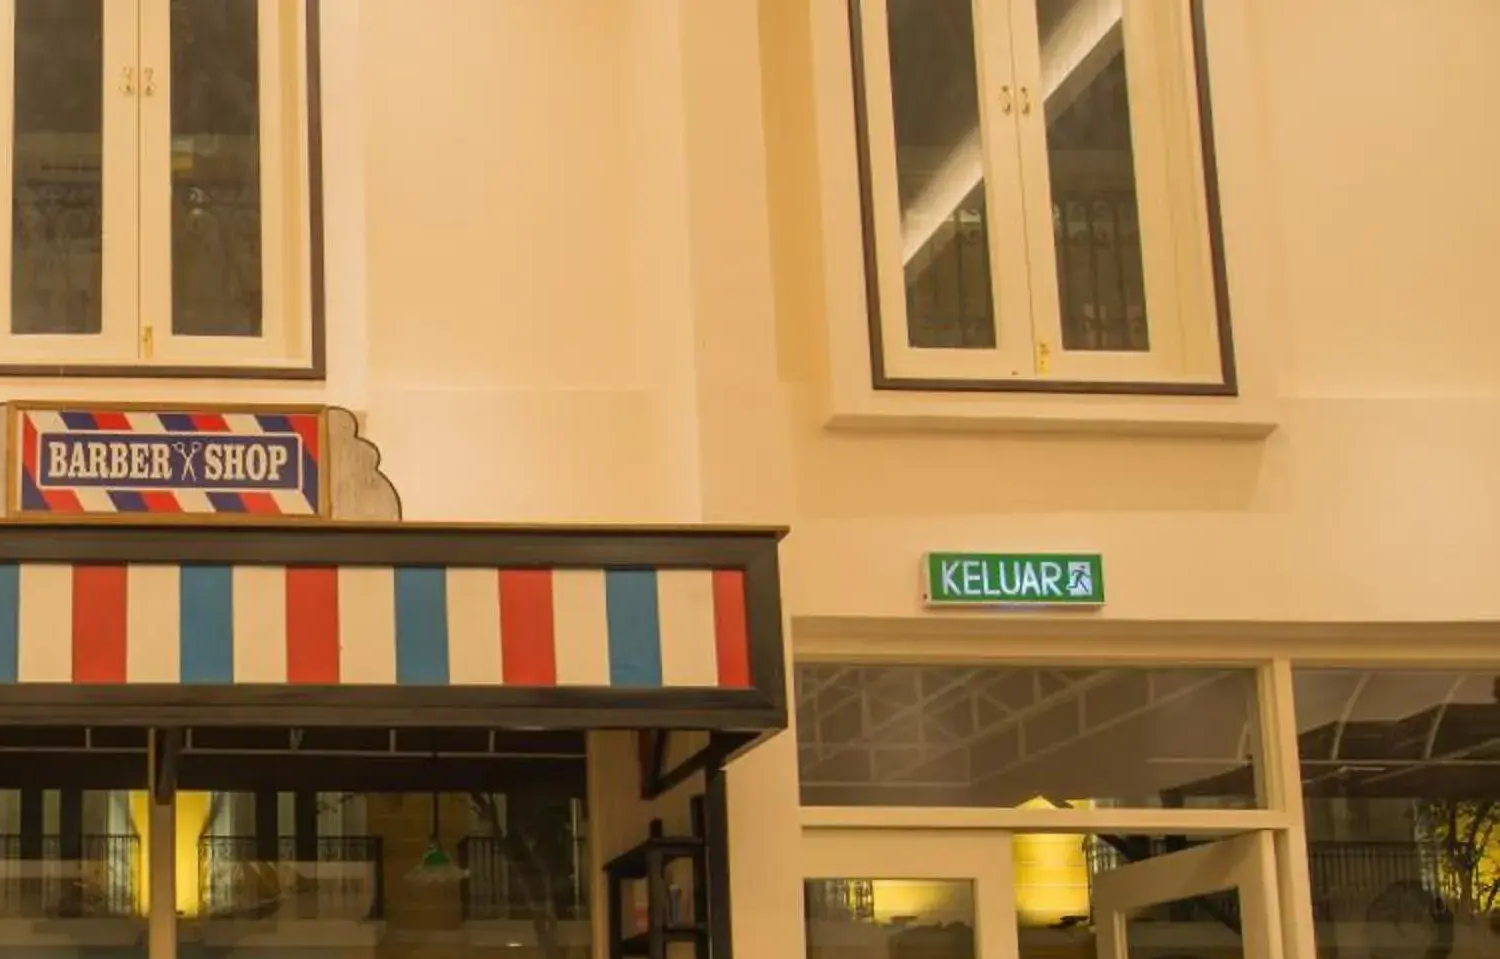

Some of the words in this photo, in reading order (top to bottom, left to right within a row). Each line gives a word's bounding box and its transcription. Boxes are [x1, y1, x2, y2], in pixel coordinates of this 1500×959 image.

[48, 441, 173, 479] BARBER
[204, 443, 288, 481] SHOP
[940, 559, 1063, 597] KELUAR
